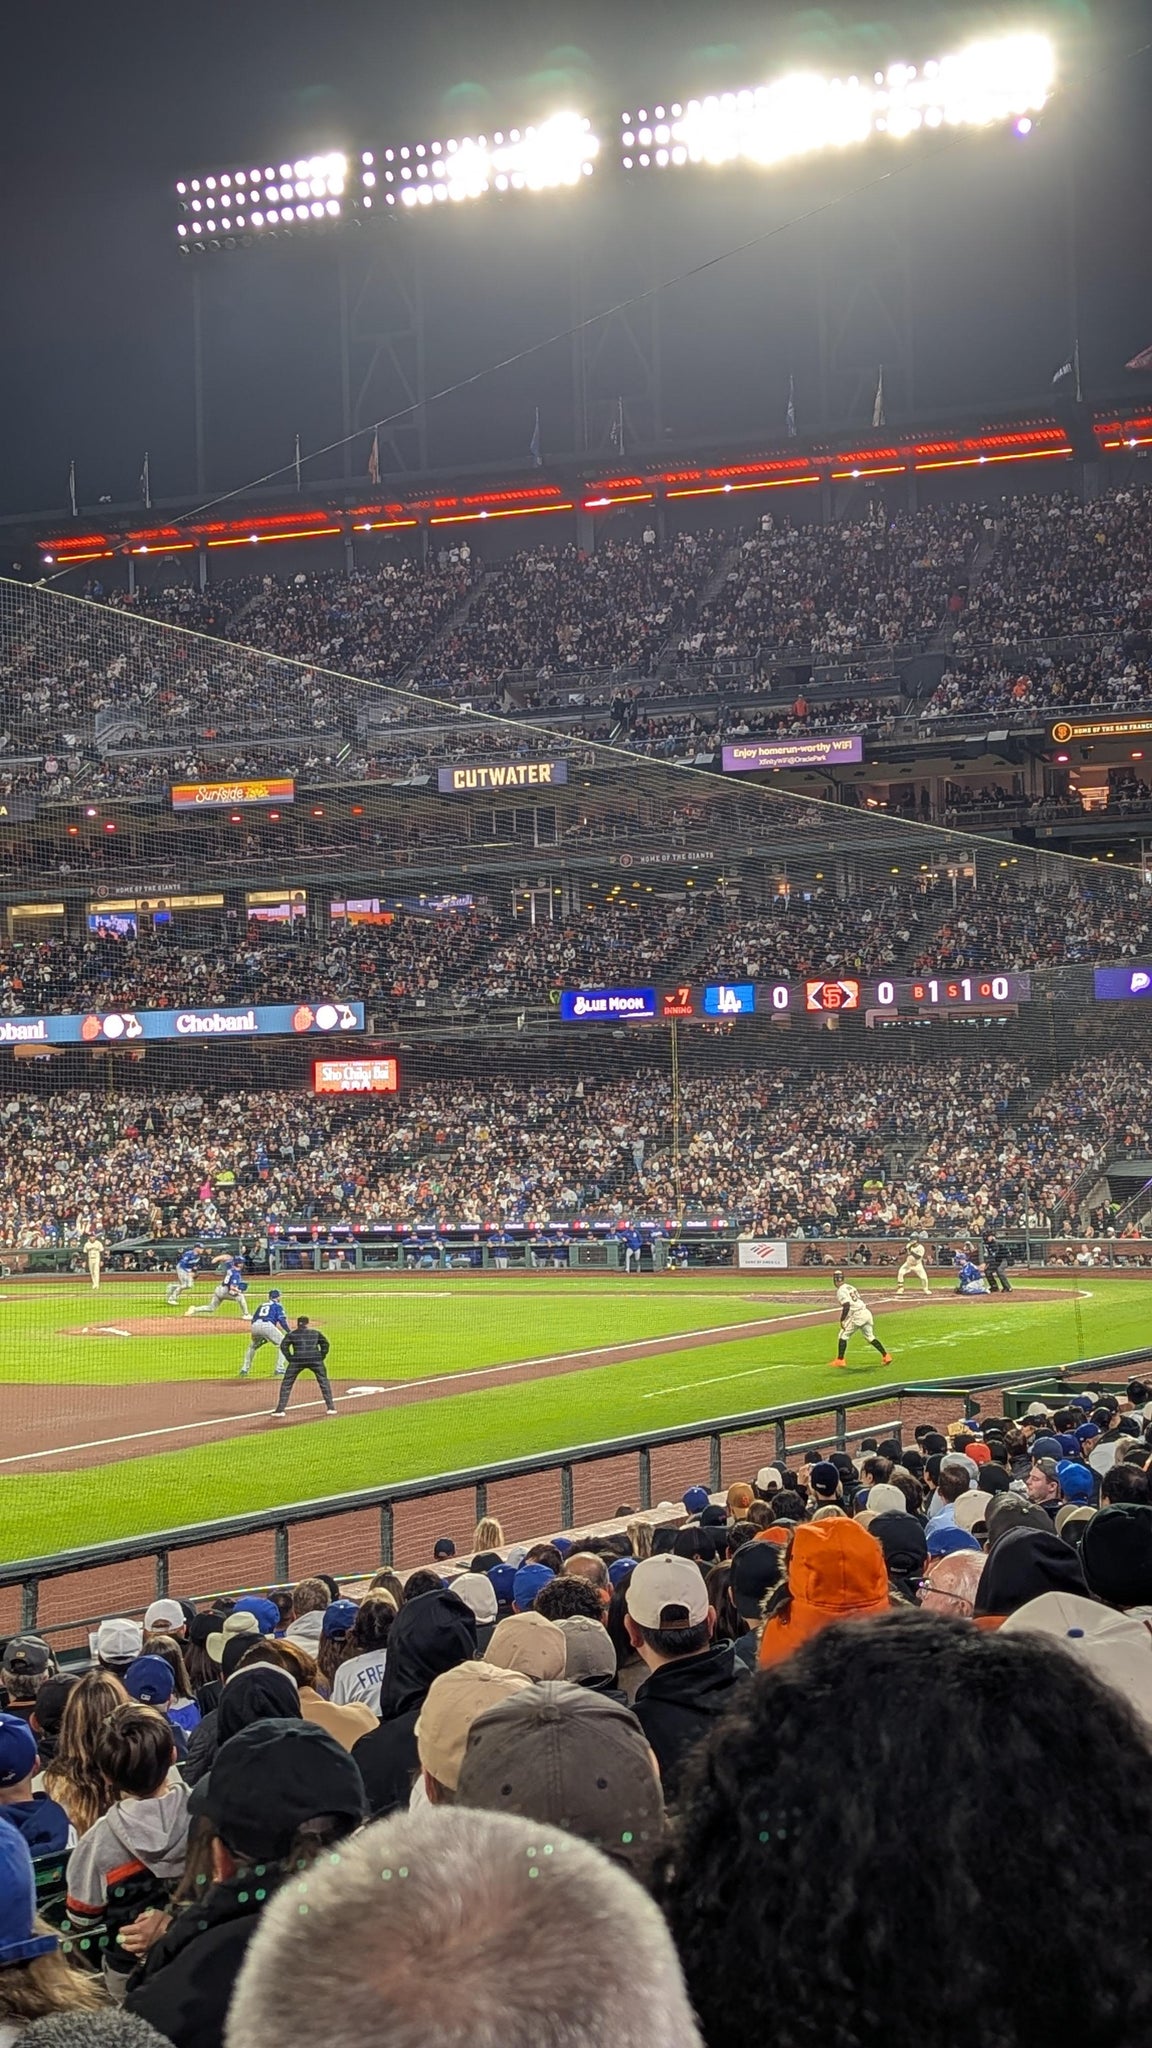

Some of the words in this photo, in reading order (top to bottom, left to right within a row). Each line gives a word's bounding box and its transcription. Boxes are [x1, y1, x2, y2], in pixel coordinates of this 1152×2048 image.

[733, 748, 757, 759] Enjoy
[758, 742, 831, 756] homerun-worthy
[832, 740, 852, 750] WiFi
[453, 763, 552, 789] CUTWATER
[195, 786, 243, 803] Surfside
[687, 852, 714, 860] GIANTS
[678, 988, 689, 1005] 7
[772, 986, 788, 1009] 0
[877, 981, 894, 1004] 0
[664, 1006, 692, 1015] INNING
